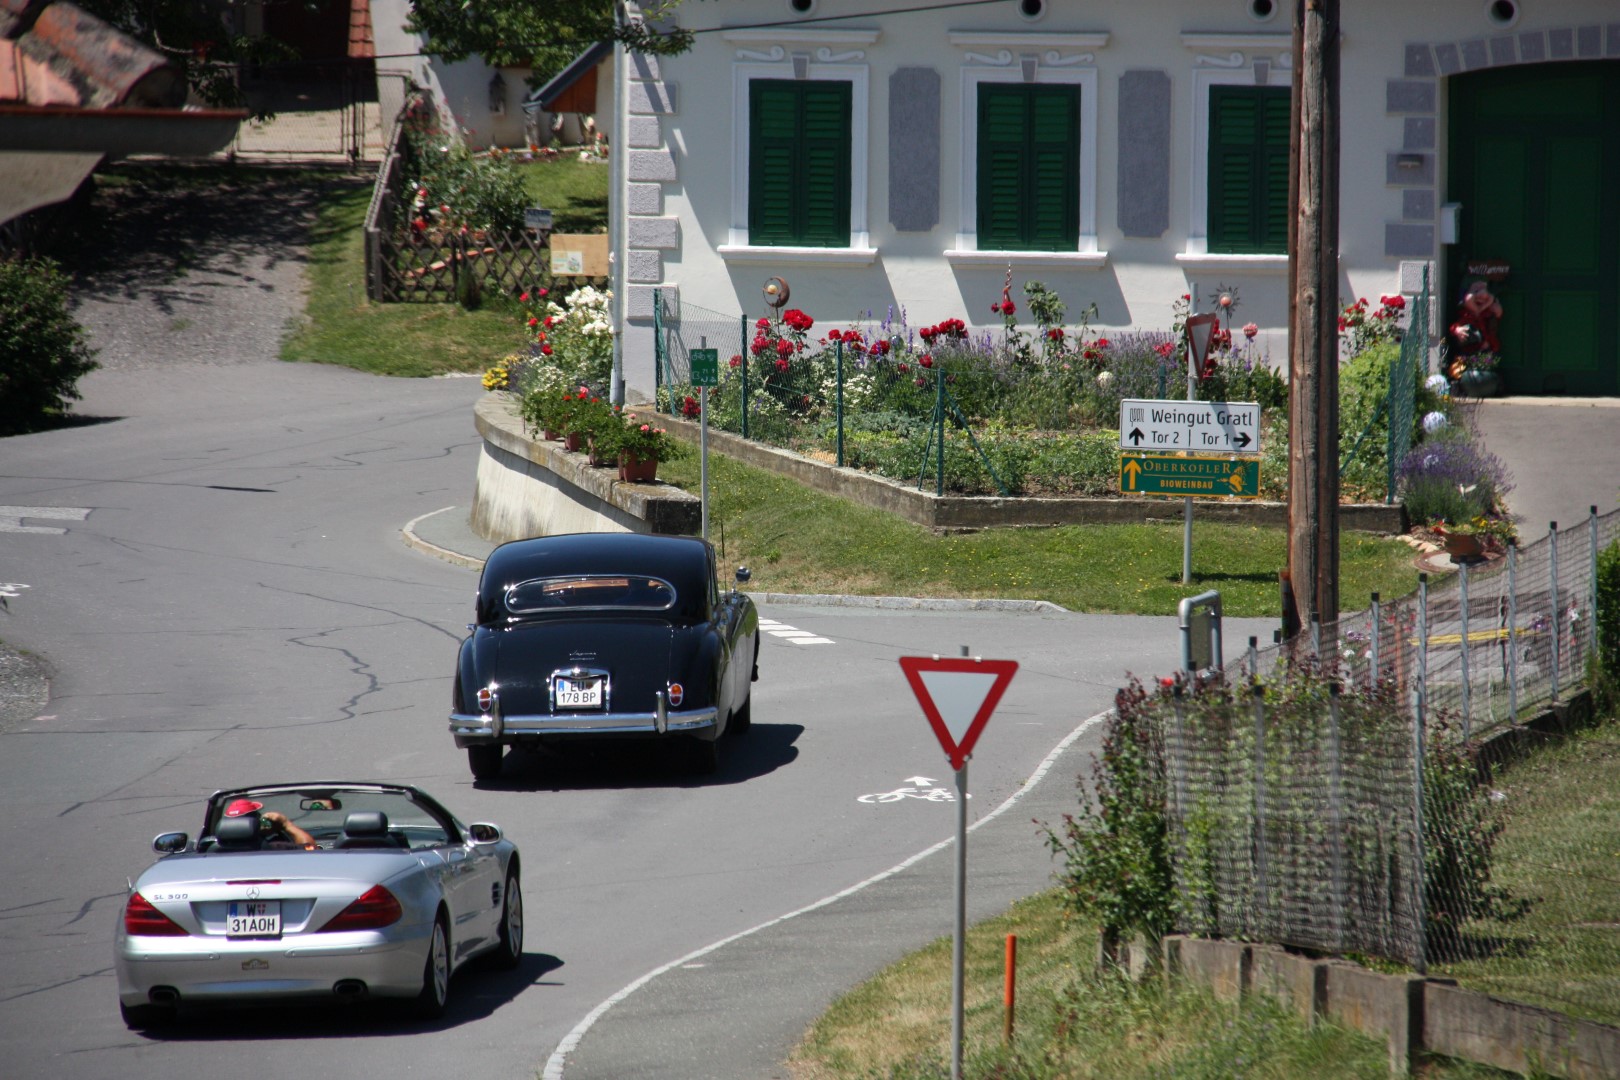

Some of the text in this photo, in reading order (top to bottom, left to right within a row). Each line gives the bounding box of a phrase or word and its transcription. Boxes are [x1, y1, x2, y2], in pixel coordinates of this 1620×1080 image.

[1151, 408, 1211, 427] Weingut
[1217, 410, 1252, 426] Gratl
[1151, 430, 1229, 445] Tor 2 Tor 1
[1143, 460, 1231, 474] OBERKOFLER
[1160, 479, 1213, 489] BIOWEINBAU
[570, 681, 585, 692] EU
[561, 692, 596, 703] 178 BP
[246, 903, 256, 918] W
